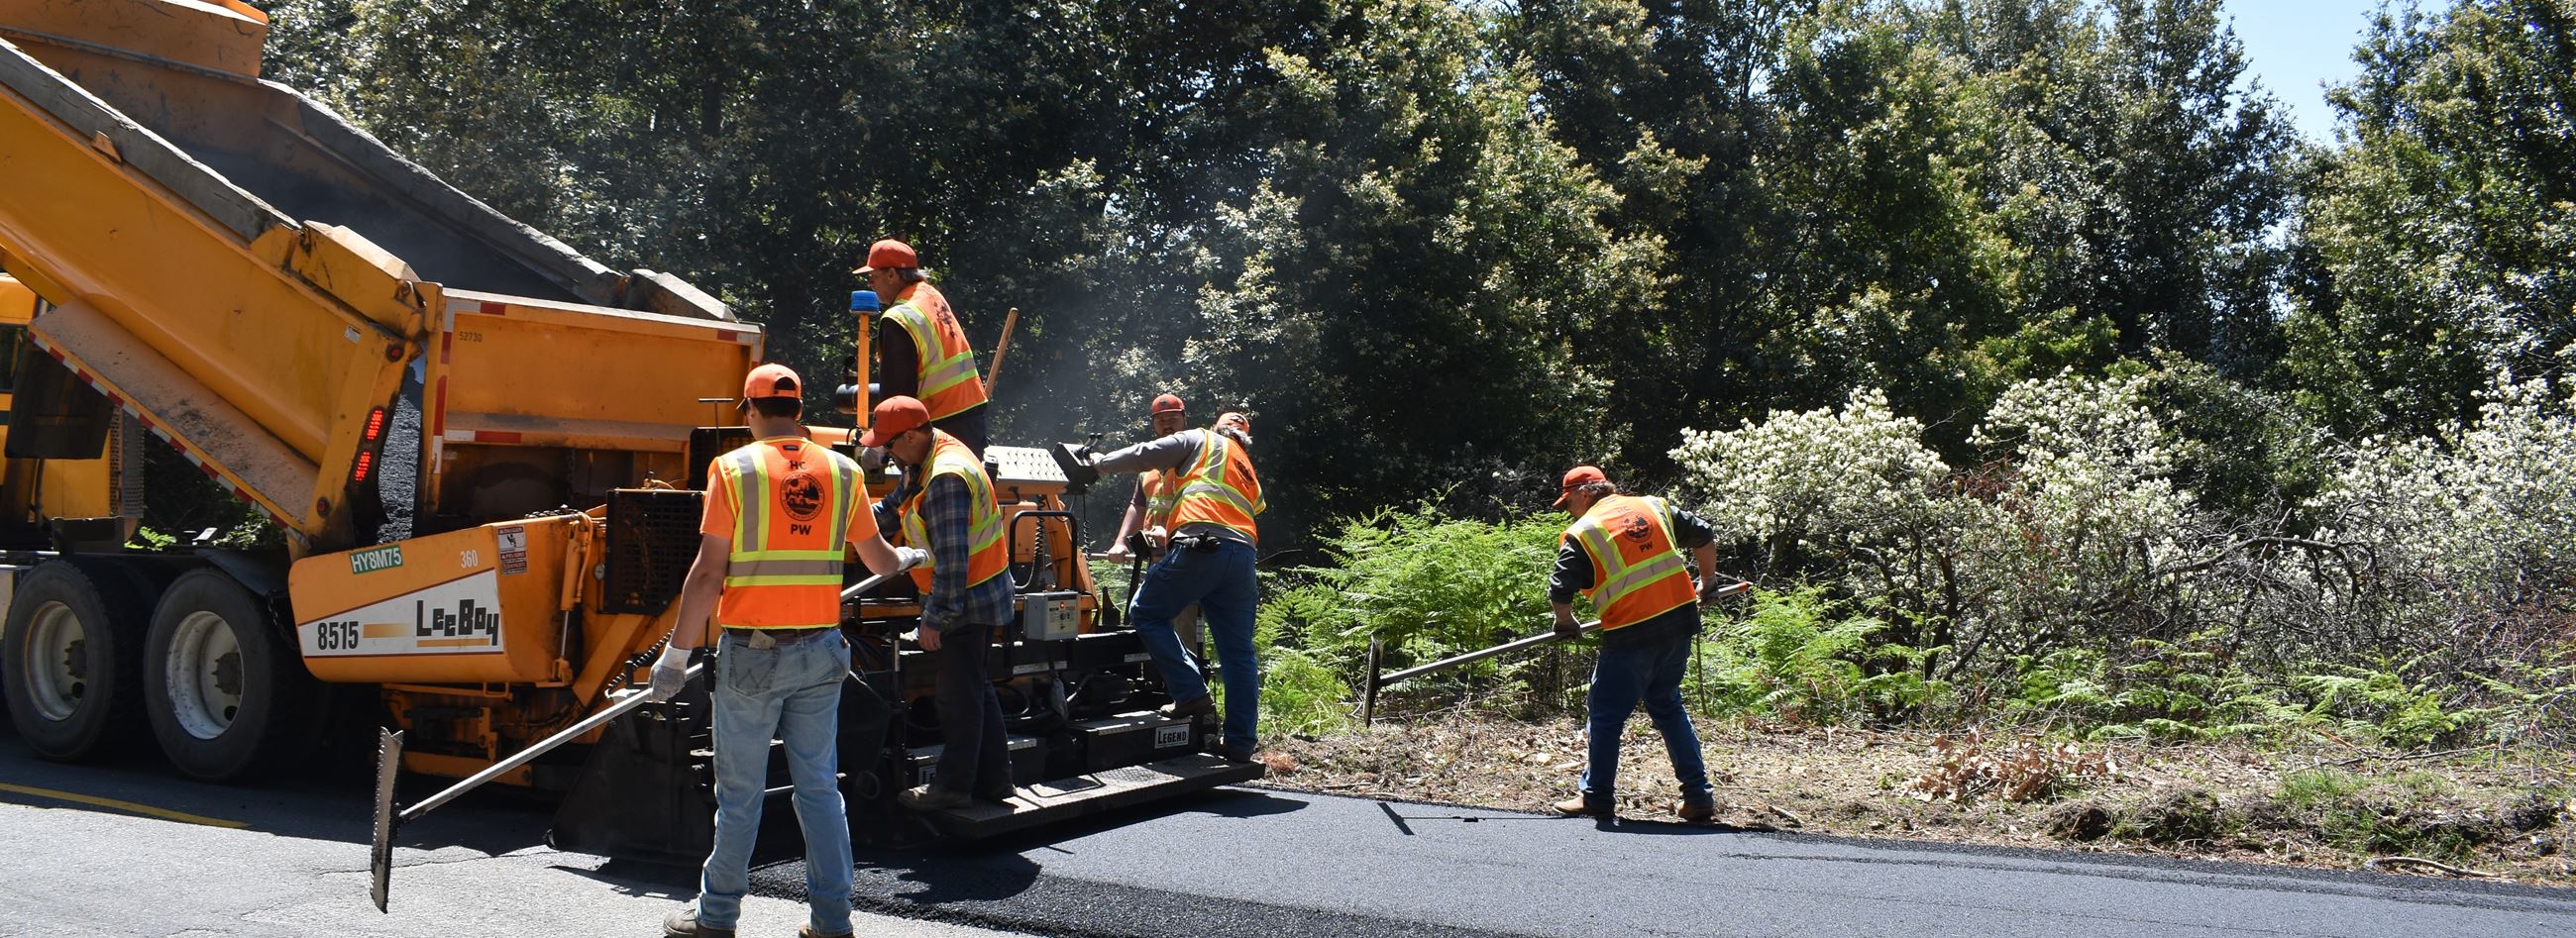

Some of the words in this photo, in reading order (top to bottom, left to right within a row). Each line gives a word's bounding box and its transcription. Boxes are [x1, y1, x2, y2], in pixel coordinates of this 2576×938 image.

[459, 331, 483, 343] 52730
[790, 460, 806, 470] HC
[791, 524, 811, 535] PW
[1640, 542, 1653, 552] PW
[351, 547, 402, 573] HY8M75
[460, 549, 479, 569] 360
[317, 620, 359, 650] 8515
